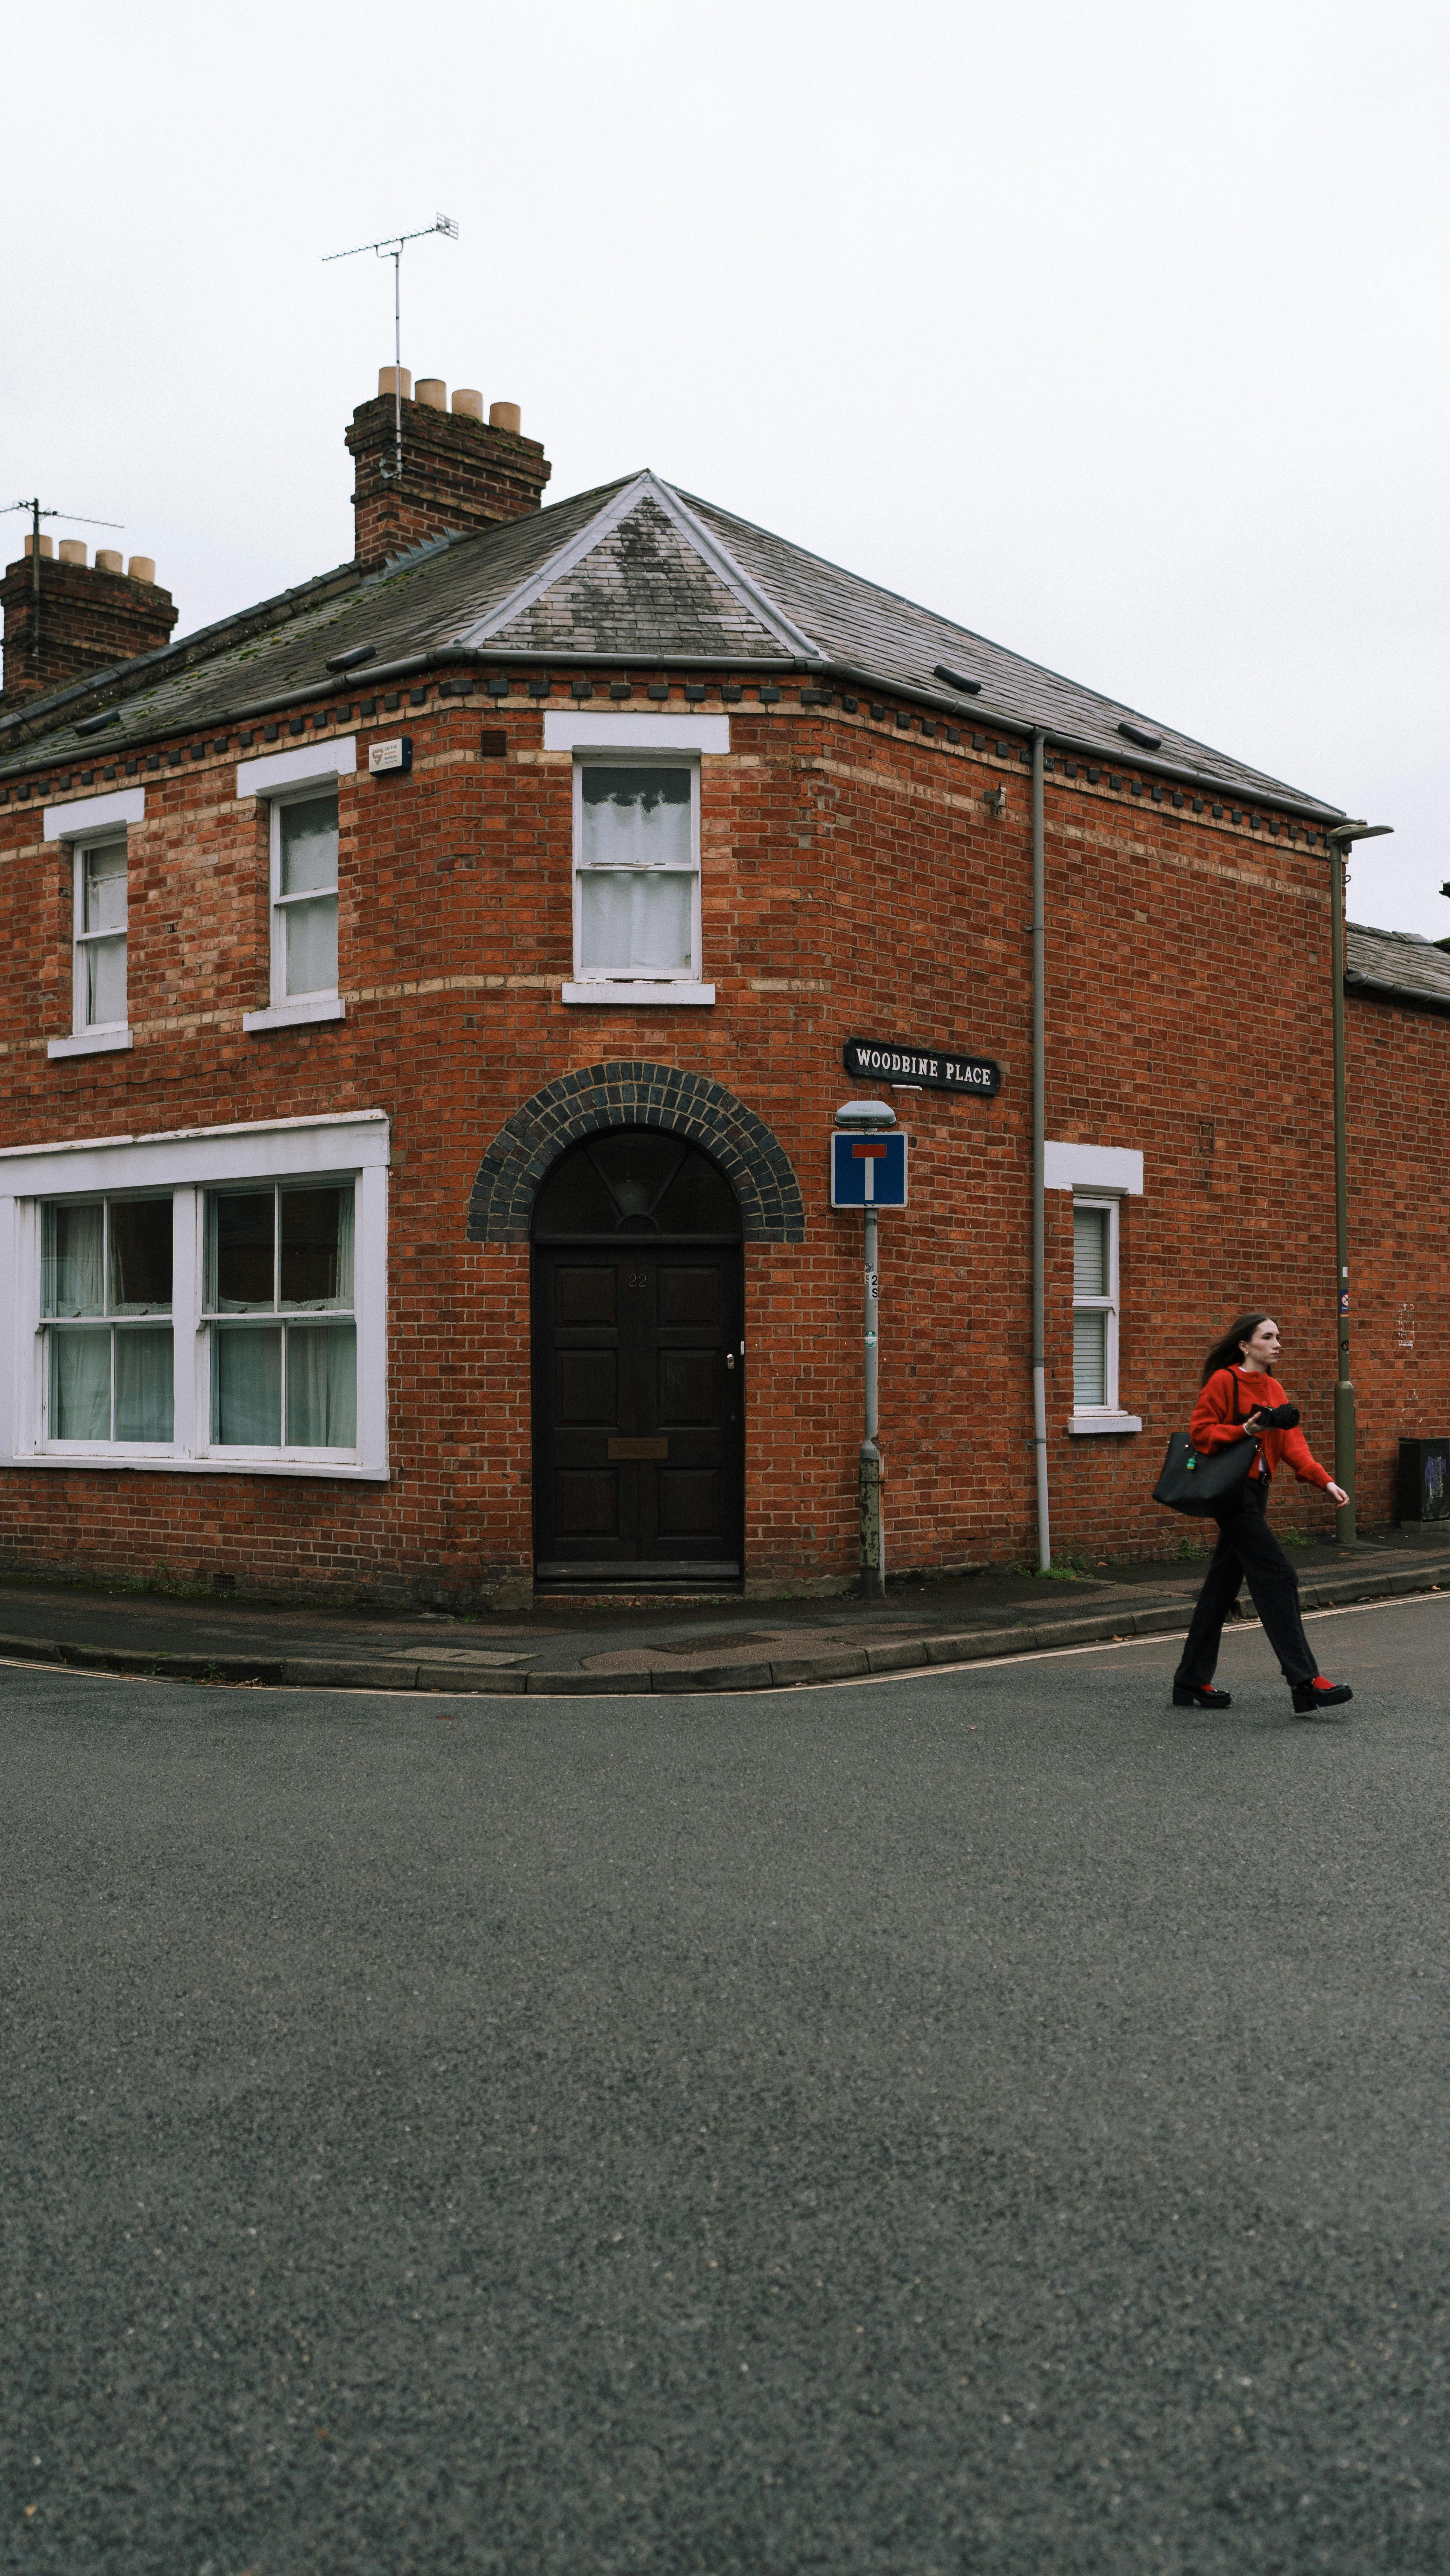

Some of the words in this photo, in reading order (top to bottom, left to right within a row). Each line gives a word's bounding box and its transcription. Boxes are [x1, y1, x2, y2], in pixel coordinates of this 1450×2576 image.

[856, 1048, 938, 1077] WOODBINE
[946, 1063, 990, 1085] PLACE
[629, 1274, 646, 1287] 22
[871, 1275, 878, 1286] 2
[872, 1288, 878, 1298] S
